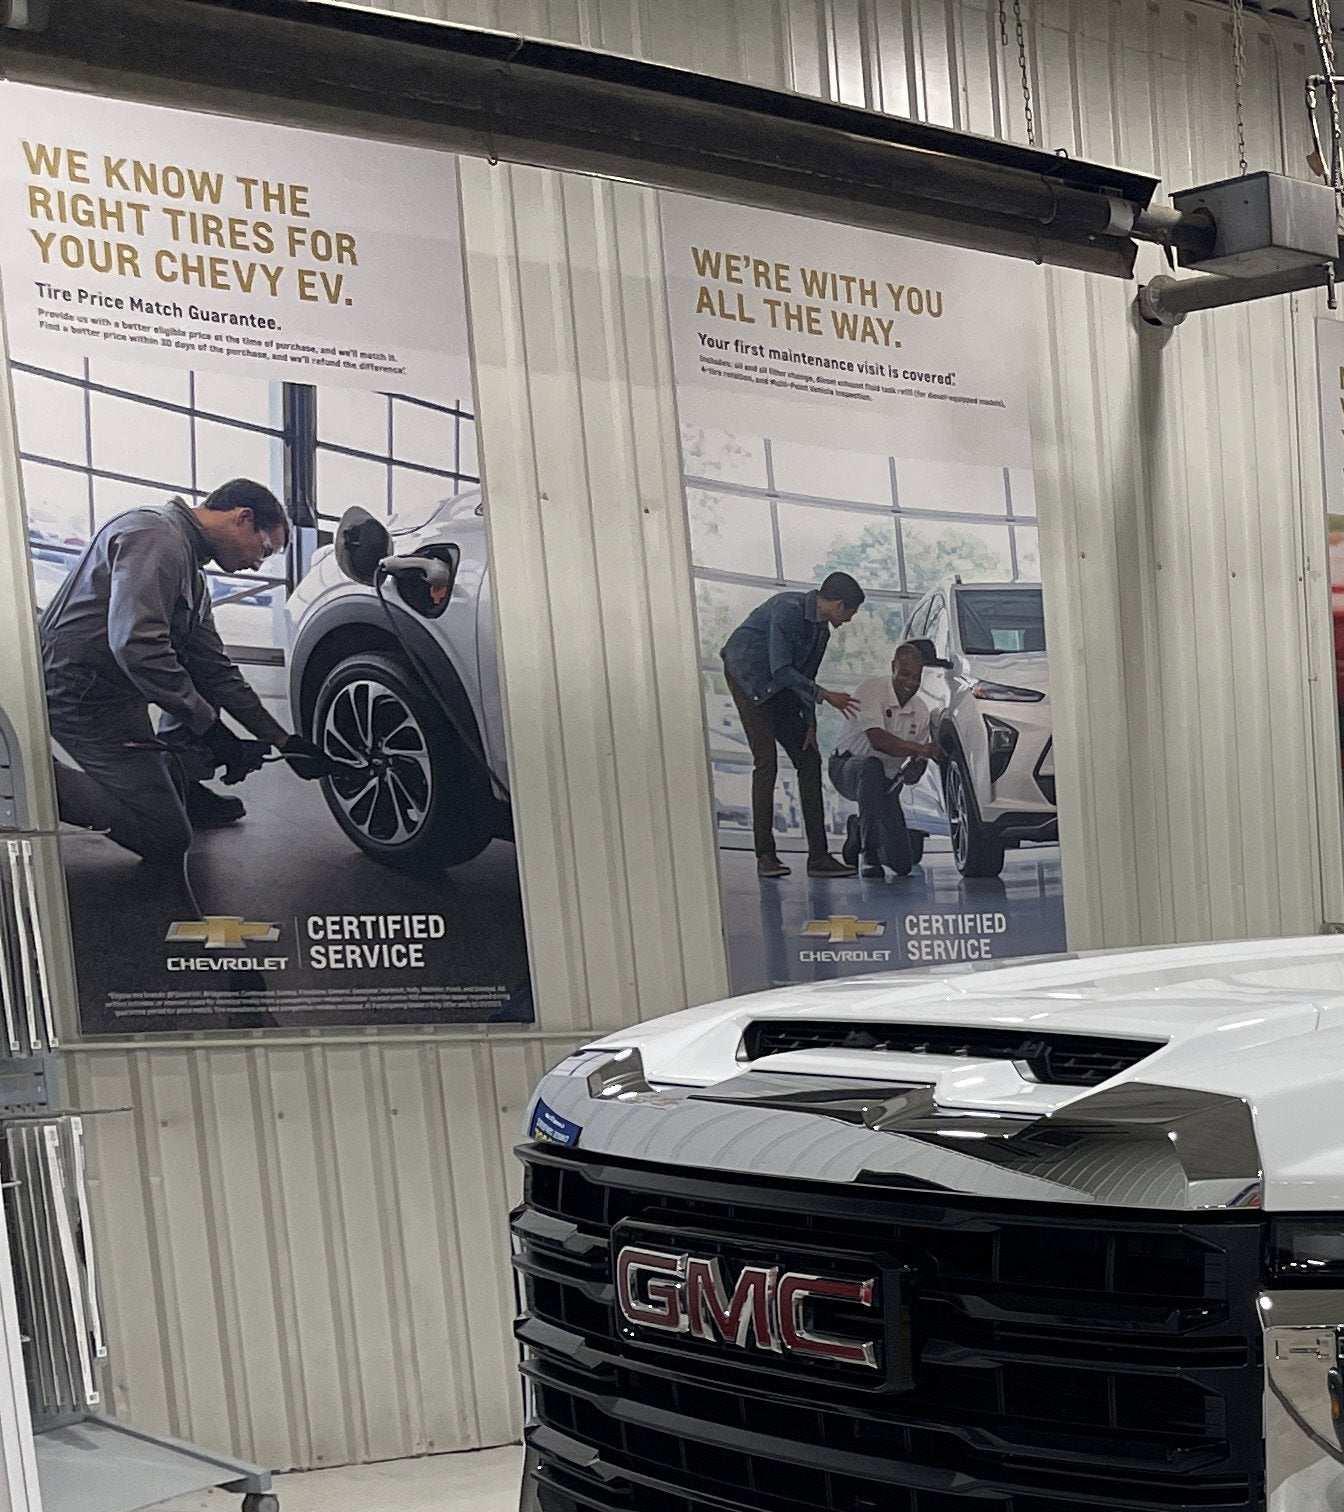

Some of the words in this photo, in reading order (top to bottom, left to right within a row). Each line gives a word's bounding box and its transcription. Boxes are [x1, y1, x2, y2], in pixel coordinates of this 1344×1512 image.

[22, 140, 90, 184] WE
[104, 155, 224, 203] KNOW
[236, 175, 311, 217] THE
[28, 185, 150, 236] RIGHT
[163, 207, 276, 253] TIRES
[288, 226, 360, 265] FOR
[30, 229, 142, 278] YOUR
[155, 249, 283, 297] CHEVY
[298, 269, 353, 306] EV.
[691, 247, 792, 293] WE'RE
[800, 267, 878, 308] WITH
[887, 282, 943, 318] YOU
[35, 282, 72, 301] Tire
[78, 289, 124, 310] Price
[129, 297, 183, 318] Match
[188, 305, 282, 331] Guarantee.
[38, 308, 74, 322] Provide
[91, 317, 112, 326] with
[122, 321, 151, 332] better
[189, 331, 211, 340] price
[696, 286, 755, 324] ALL
[763, 298, 823, 336] THE
[832, 310, 902, 348] WAY.
[71, 326, 100, 336] better
[103, 332, 127, 341] price
[698, 332, 730, 350] Your
[734, 339, 765, 358] first
[768, 348, 854, 372] maintenance
[857, 361, 886, 376] visit
[888, 364, 899, 379] is
[307, 914, 446, 941] CERTIFIED
[905, 912, 1007, 936] CERTIFIED
[166, 956, 289, 971] CHEVROLET
[309, 943, 425, 969] SERVICE
[800, 950, 891, 962] CHEVROLET
[906, 938, 992, 961] SERVICE
[617, 1245, 878, 1369] GMC
